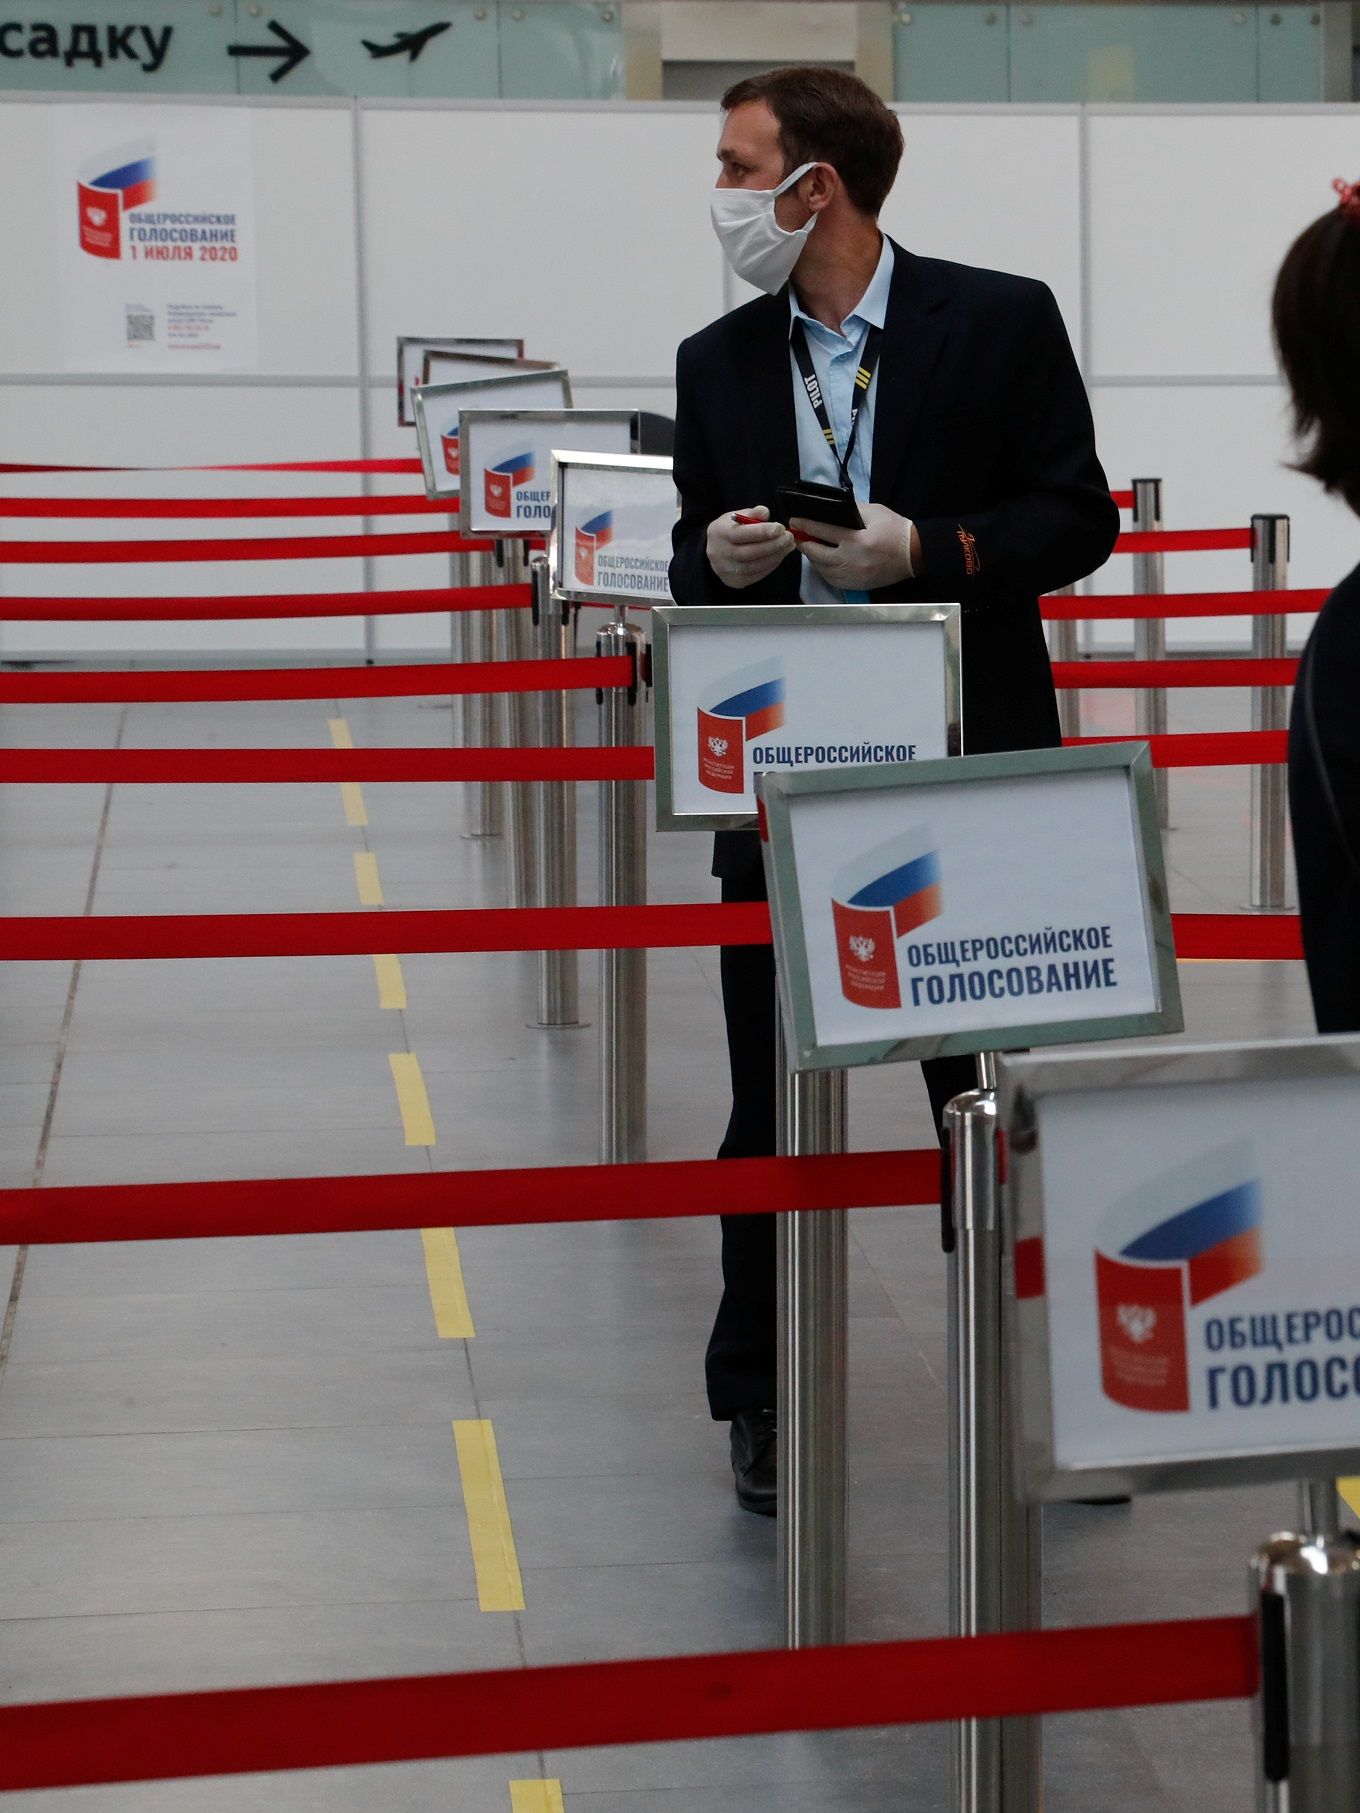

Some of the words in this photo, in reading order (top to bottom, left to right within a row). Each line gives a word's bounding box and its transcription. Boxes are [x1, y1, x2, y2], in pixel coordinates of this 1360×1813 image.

[0, 22, 173, 73] садку
[129, 211, 236, 227] ОБЩЕРОССИЙСКОЕ
[129, 228, 236, 243] ГОЛОСОВАНИЕ
[131, 245, 138, 261] 1
[144, 245, 193, 261] ИЮЛЯ
[199, 245, 238, 262] 2020
[804, 374, 823, 409] PILOT
[598, 555, 669, 573] ОБЩЕРОССИЙСКОЕ
[597, 571, 669, 593] ГОЛОСОВАНИЕ
[753, 741, 916, 767] ОБЩЕРОССИЙСКОЕ
[907, 926, 1113, 968] ОБЩЕРОССИЙСКОЕ
[911, 958, 1118, 1007] ГОЛОСОВАНИЕ
